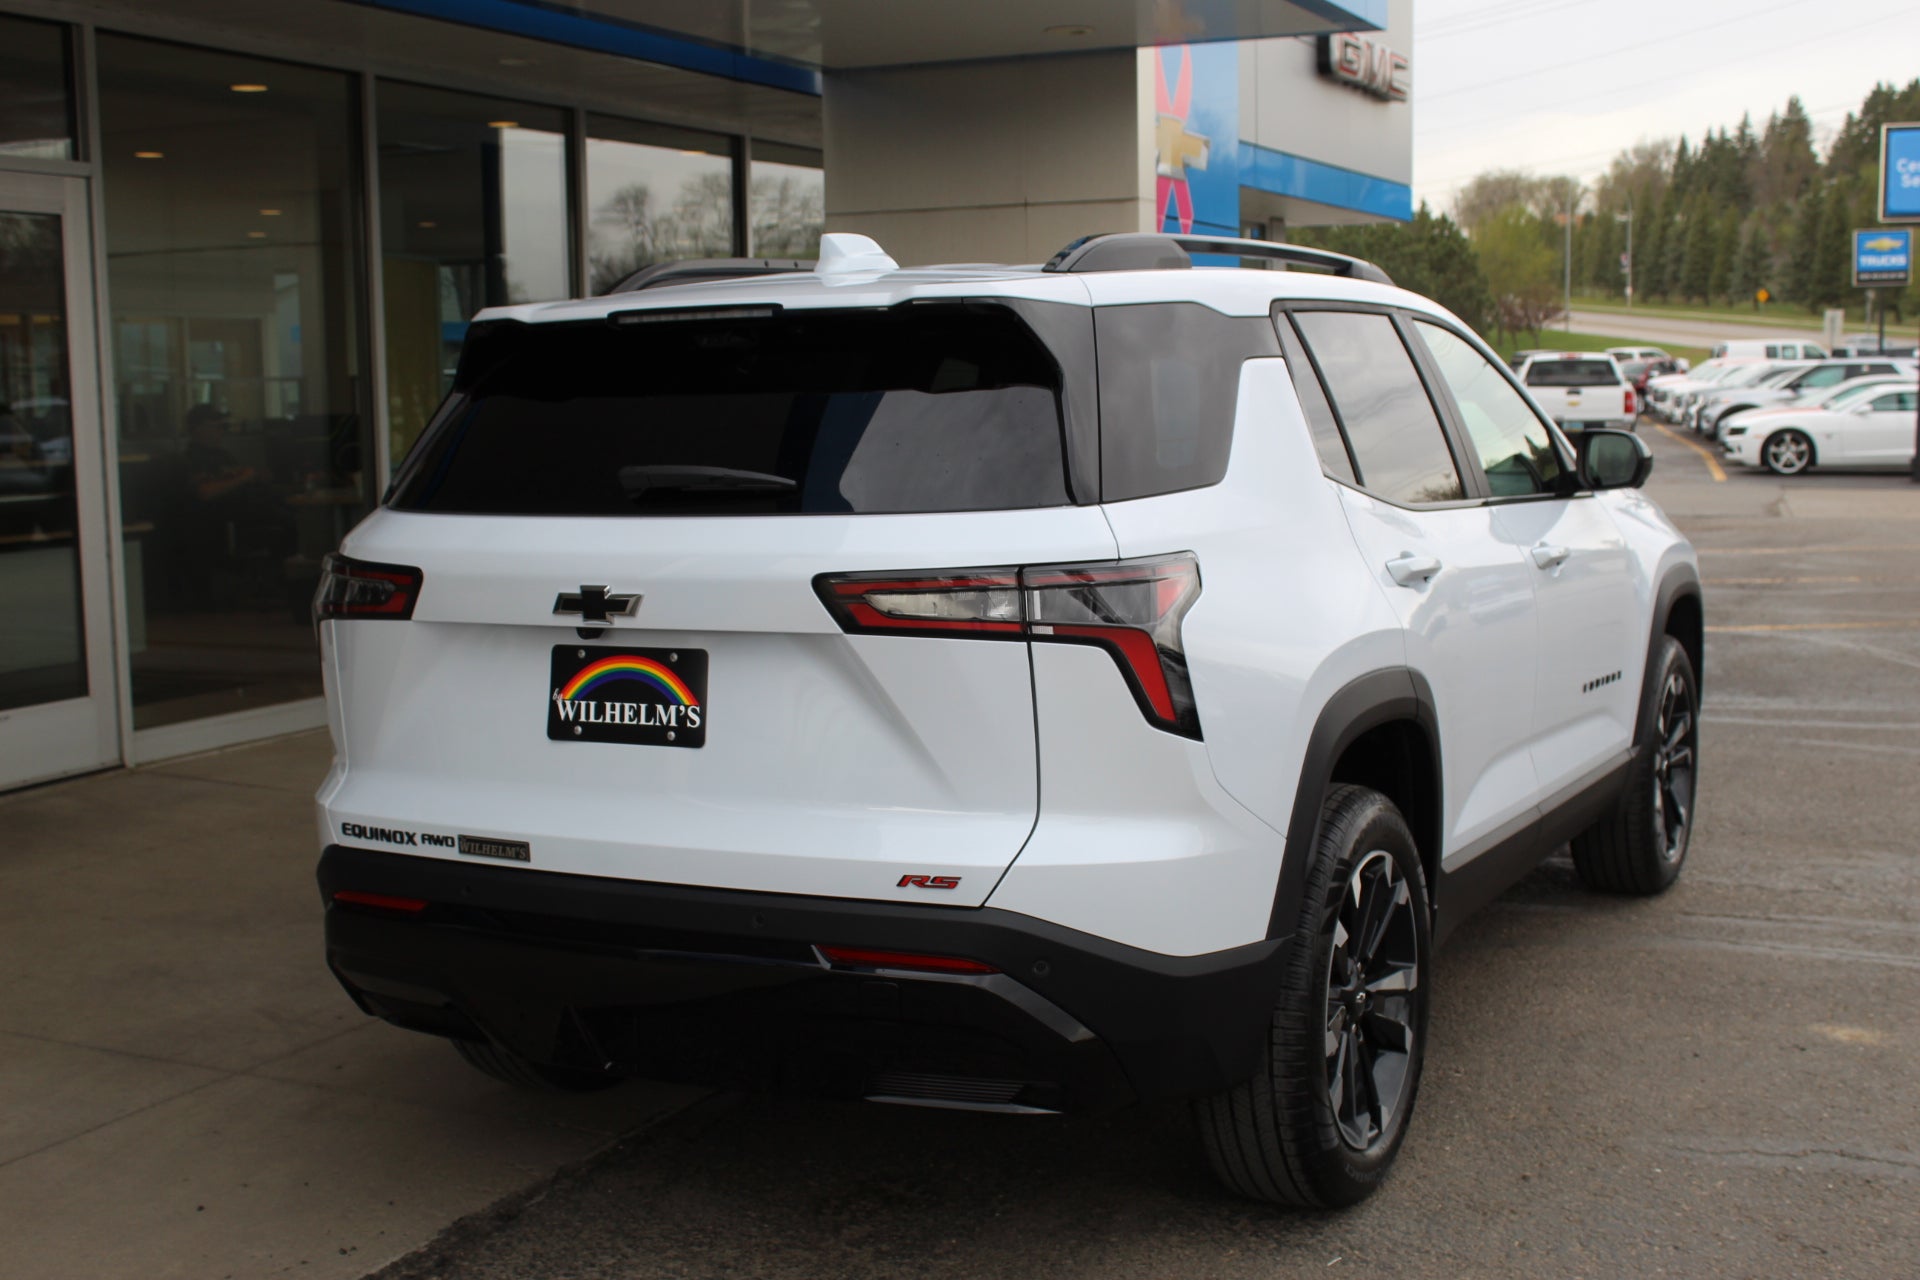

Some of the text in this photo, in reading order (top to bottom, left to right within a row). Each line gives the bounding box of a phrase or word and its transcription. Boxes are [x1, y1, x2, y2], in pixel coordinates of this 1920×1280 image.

[1331, 32, 1409, 97] GMC
[556, 700, 701, 728] WILHELM'S
[341, 822, 455, 848] EQUINOX AWD
[460, 839, 527, 860] WILHELM'S
[896, 874, 962, 889] RS
